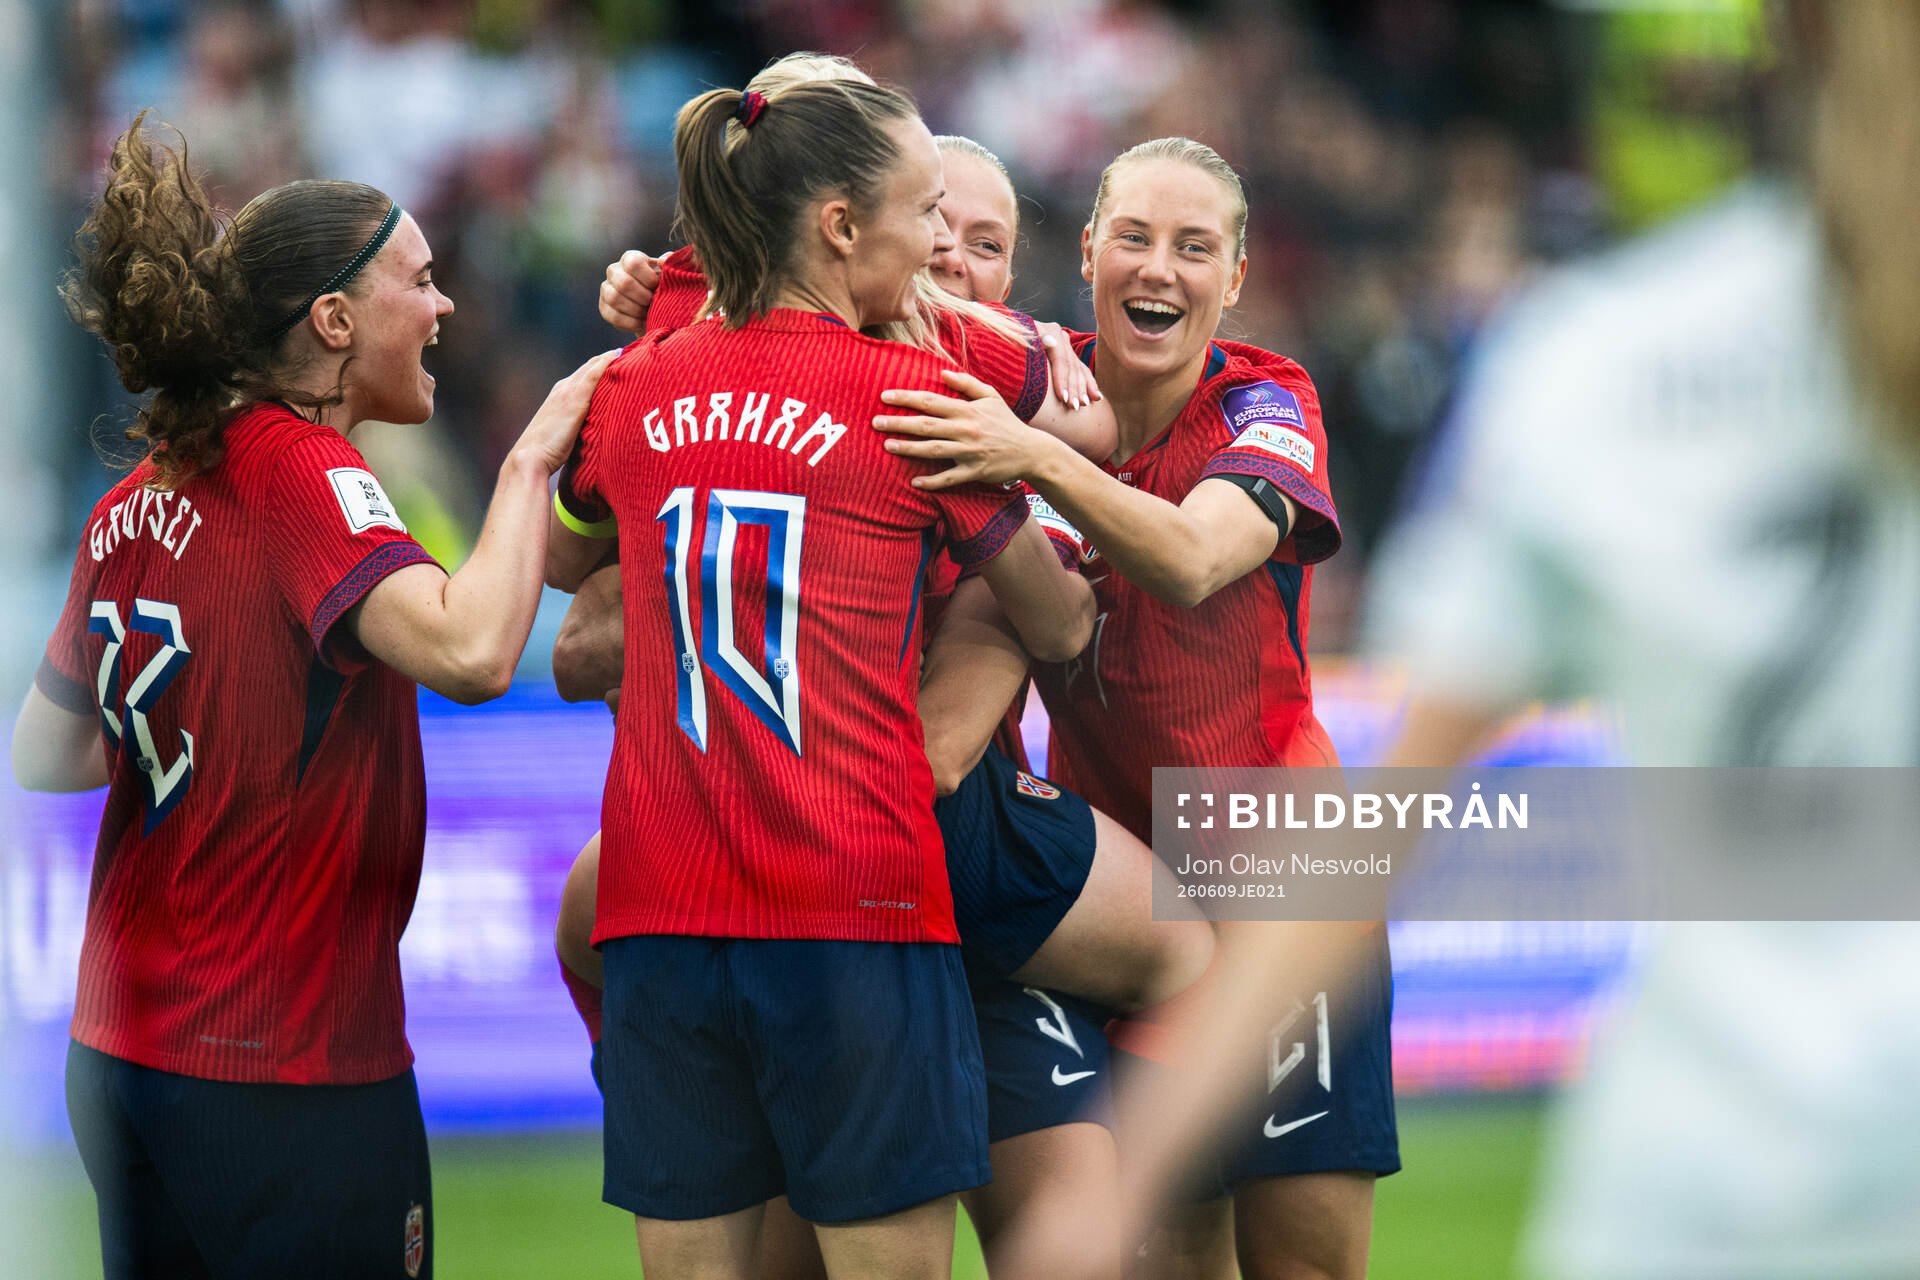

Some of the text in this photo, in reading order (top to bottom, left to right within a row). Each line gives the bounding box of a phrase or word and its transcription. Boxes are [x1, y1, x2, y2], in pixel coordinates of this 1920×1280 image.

[643, 392, 848, 467] GRAHAM
[1234, 407, 1295, 421] EUROPEAN
[1236, 412, 1298, 427] QUALIFIERS
[656, 486, 807, 759] 10
[87, 598, 194, 839] 22
